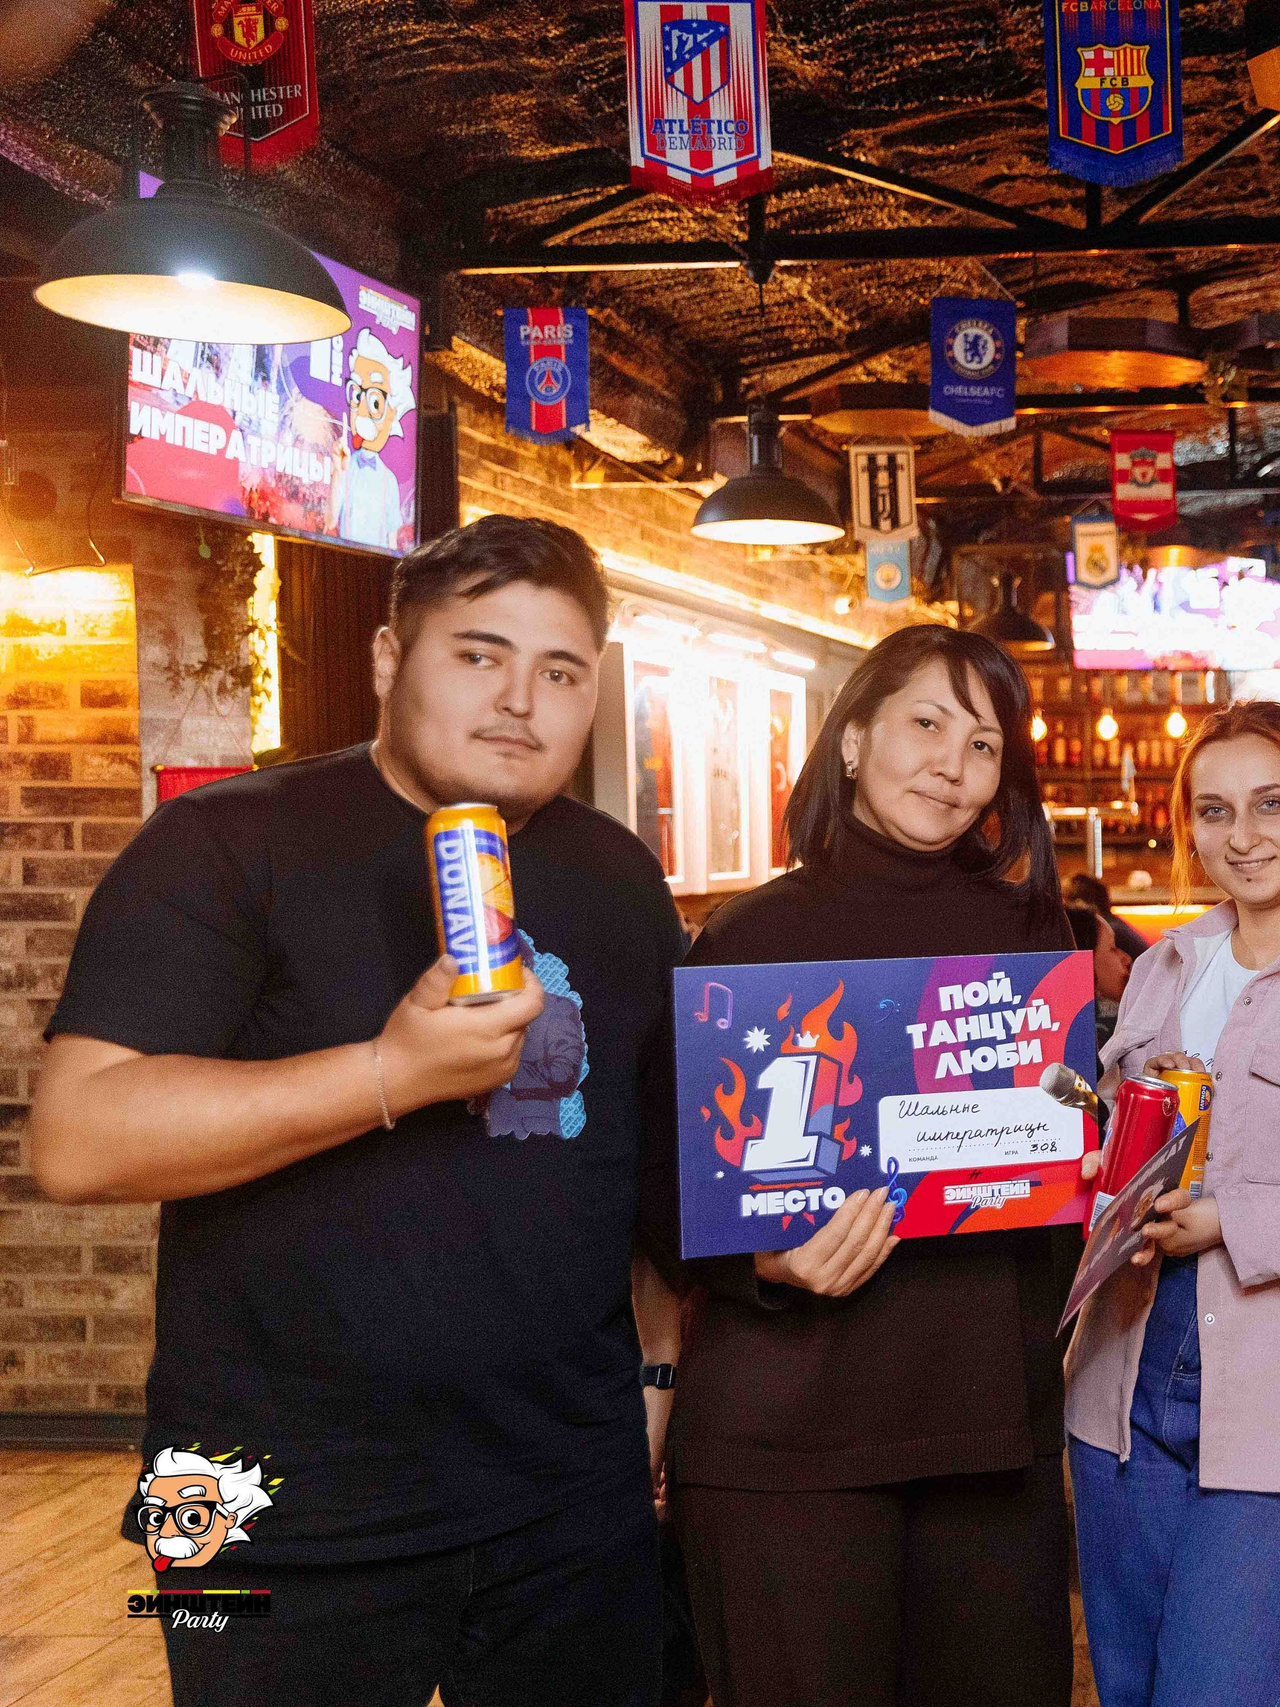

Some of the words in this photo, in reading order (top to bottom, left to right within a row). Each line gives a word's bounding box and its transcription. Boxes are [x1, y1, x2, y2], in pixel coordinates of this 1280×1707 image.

[230, 44, 273, 60] UNITED
[217, 84, 302, 105] ANHESTER
[1100, 77, 1130, 87] FCB
[652, 115, 748, 135] ATLÉTICO
[520, 324, 574, 340] PARIS
[132, 346, 280, 420] ШАЛЬНЫЕ
[129, 402, 332, 485] ИМПЕРАТРИЦЫ
[939, 971, 1022, 1012] ПОЙ,
[906, 998, 1061, 1050] ТАНЦУЙ,
[935, 1038, 1043, 1080] ЛЮБИ
[742, 1054, 826, 1172] 1
[916, 1121, 1050, 1153] императрицы
[1029, 1141, 1058, 1153] 308
[908, 1155, 939, 1163] КОМАНДА
[740, 1186, 846, 1217] МЕСТО
[971, 1195, 1007, 1209] Party
